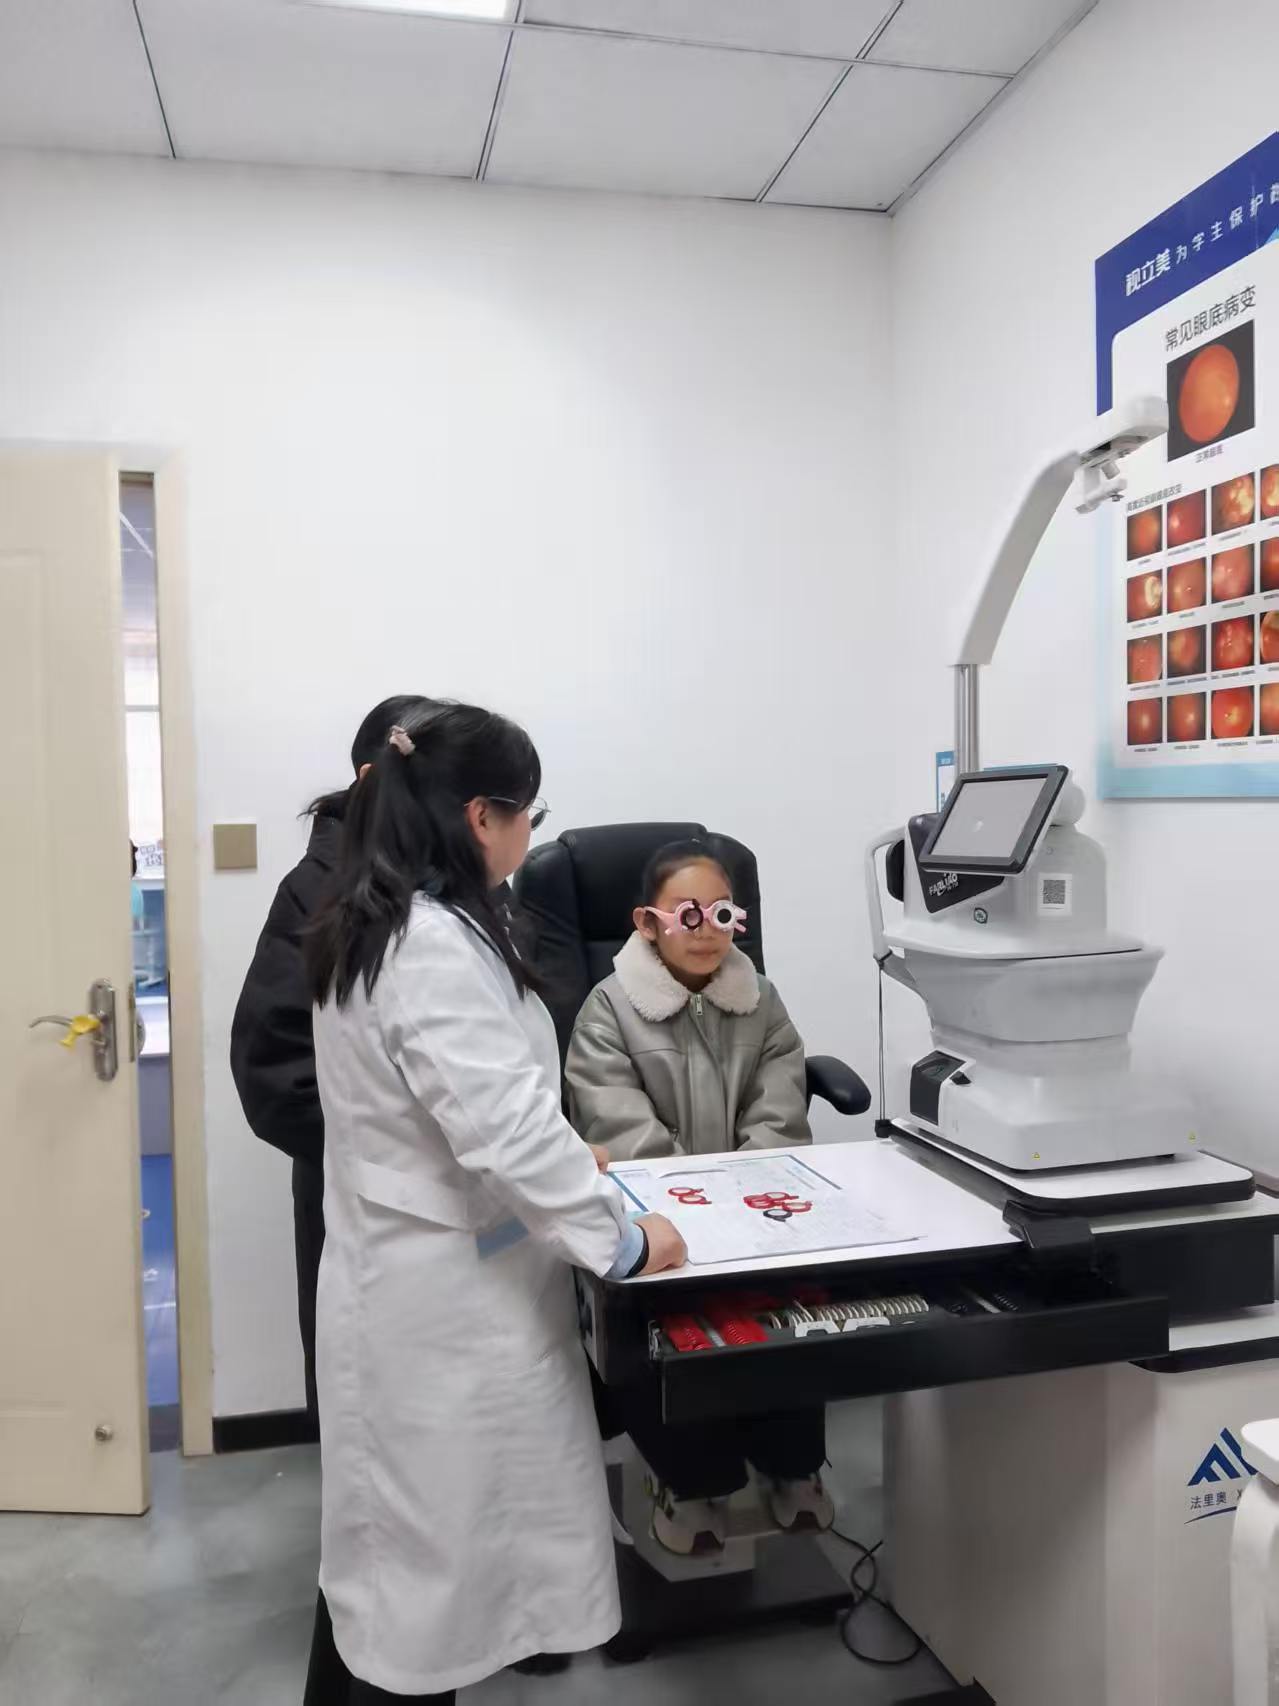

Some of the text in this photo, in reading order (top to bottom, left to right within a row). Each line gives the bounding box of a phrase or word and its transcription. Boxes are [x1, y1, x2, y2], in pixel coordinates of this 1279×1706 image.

[1165, 285, 1256, 352] 常见眼底病变
[1190, 1491, 1227, 1510] 法里奥
